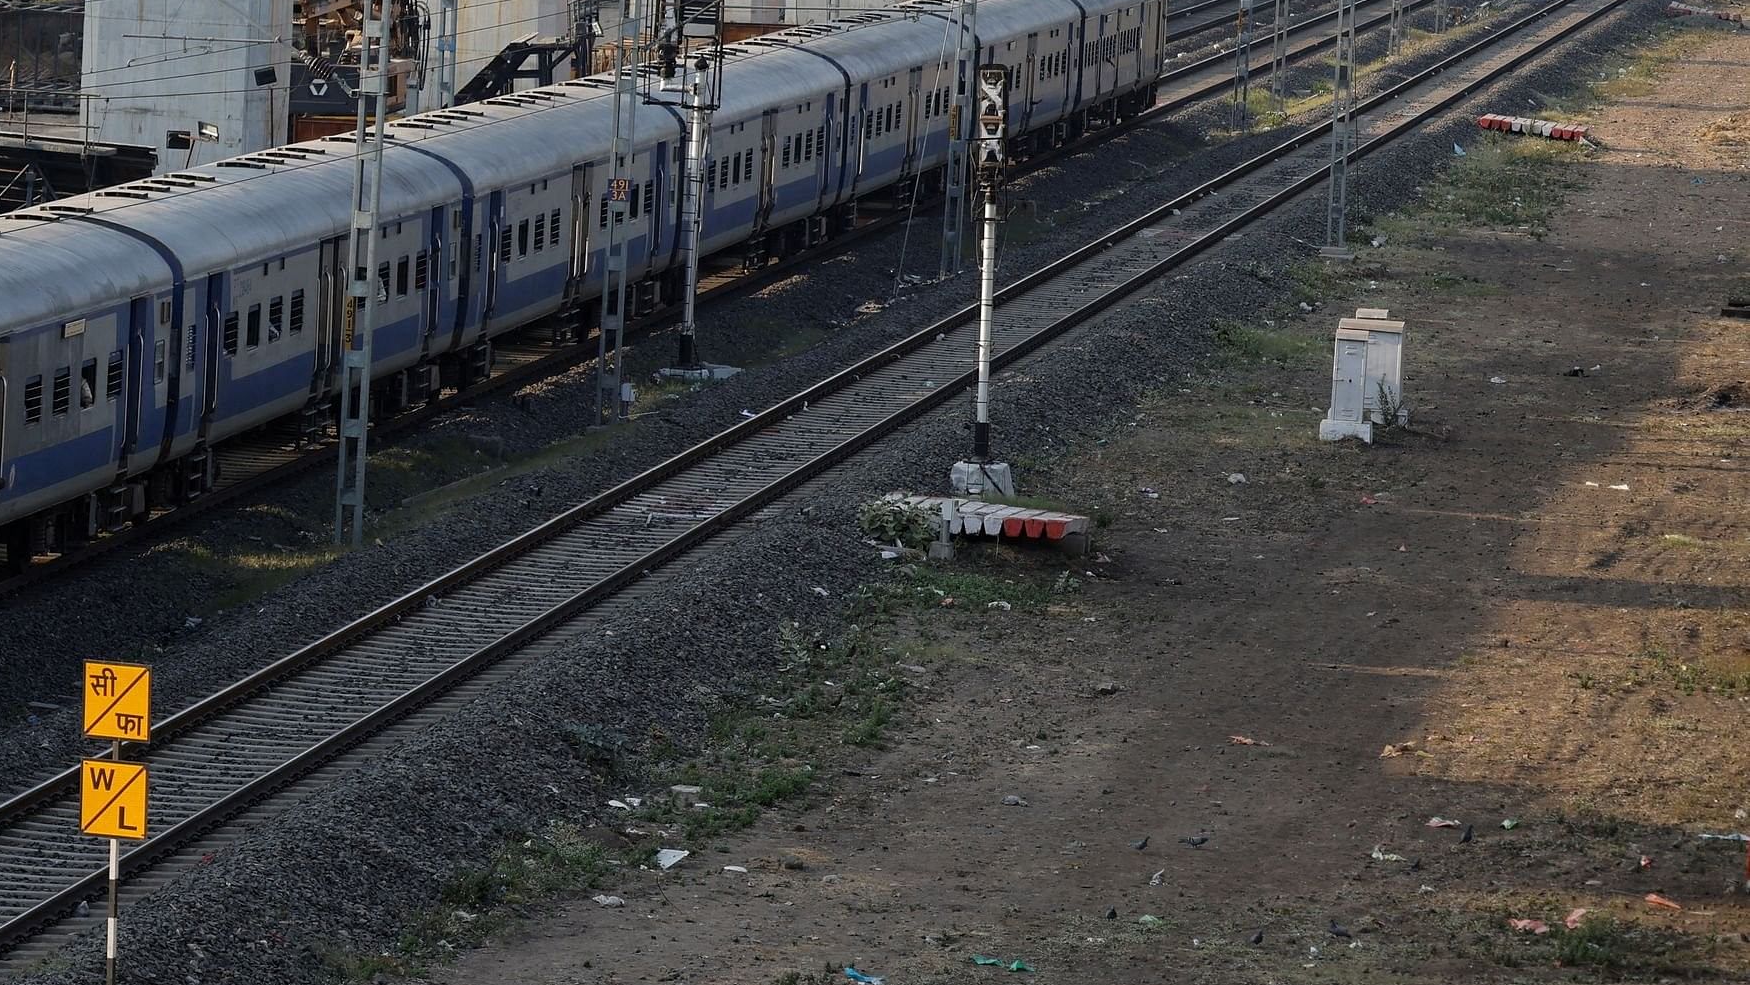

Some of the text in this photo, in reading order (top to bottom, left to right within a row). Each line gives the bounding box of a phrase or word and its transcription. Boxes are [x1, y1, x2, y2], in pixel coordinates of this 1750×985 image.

[610, 179, 629, 191] 491
[611, 191, 626, 200] 3A
[89, 667, 118, 698] सी
[114, 711, 144, 737] फा
[90, 766, 115, 792] W
[118, 805, 138, 831] L
